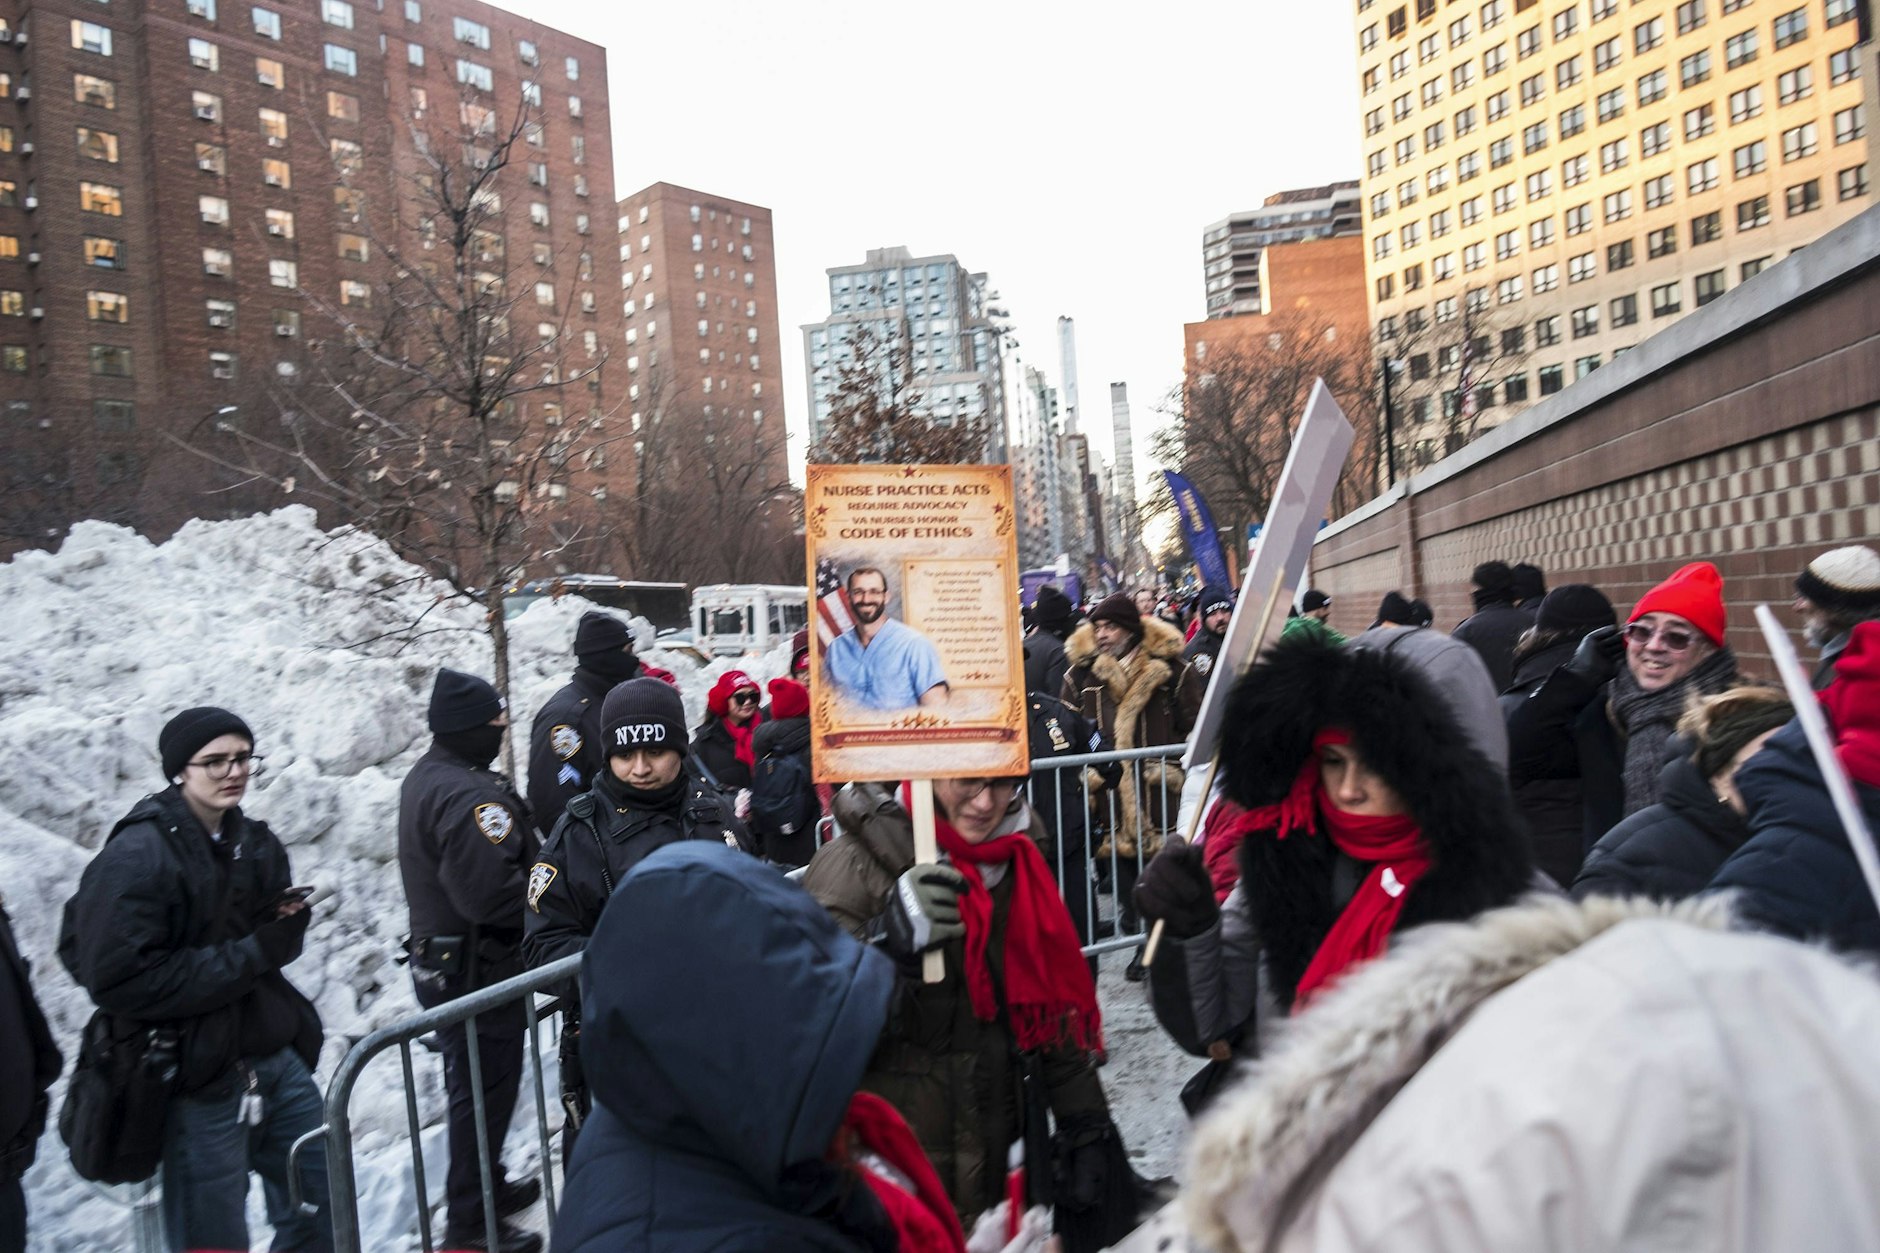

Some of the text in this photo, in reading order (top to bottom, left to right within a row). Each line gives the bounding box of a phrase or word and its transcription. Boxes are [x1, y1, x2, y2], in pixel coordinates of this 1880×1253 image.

[823, 484, 990, 496] NURSE PRACTICE ACTS
[848, 502, 968, 511] REQUIRE ADVOCACY
[852, 516, 958, 524] VA NURSES HONOR
[840, 526, 973, 539] CODE OF ETHICS
[615, 724, 666, 745] NYPD
